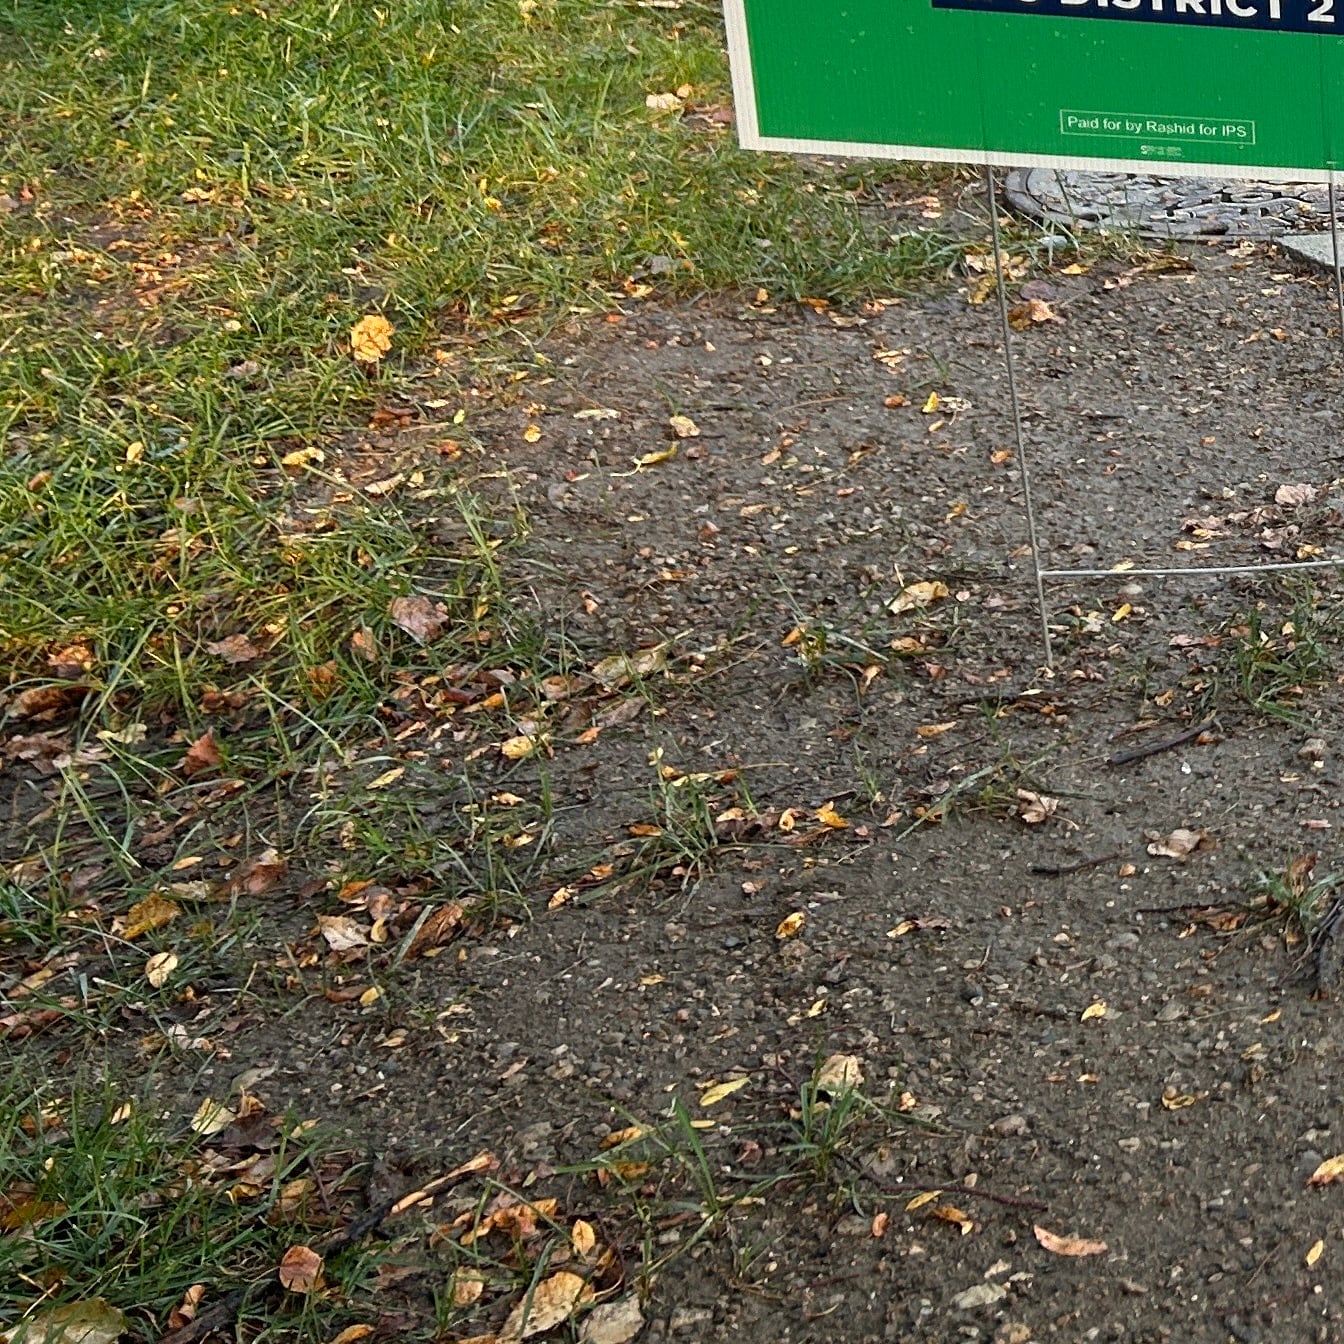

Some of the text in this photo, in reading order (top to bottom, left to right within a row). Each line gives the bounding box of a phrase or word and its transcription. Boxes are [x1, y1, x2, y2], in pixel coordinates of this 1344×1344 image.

[1067, 116, 1247, 137] Paid for by Rashid for IPS
